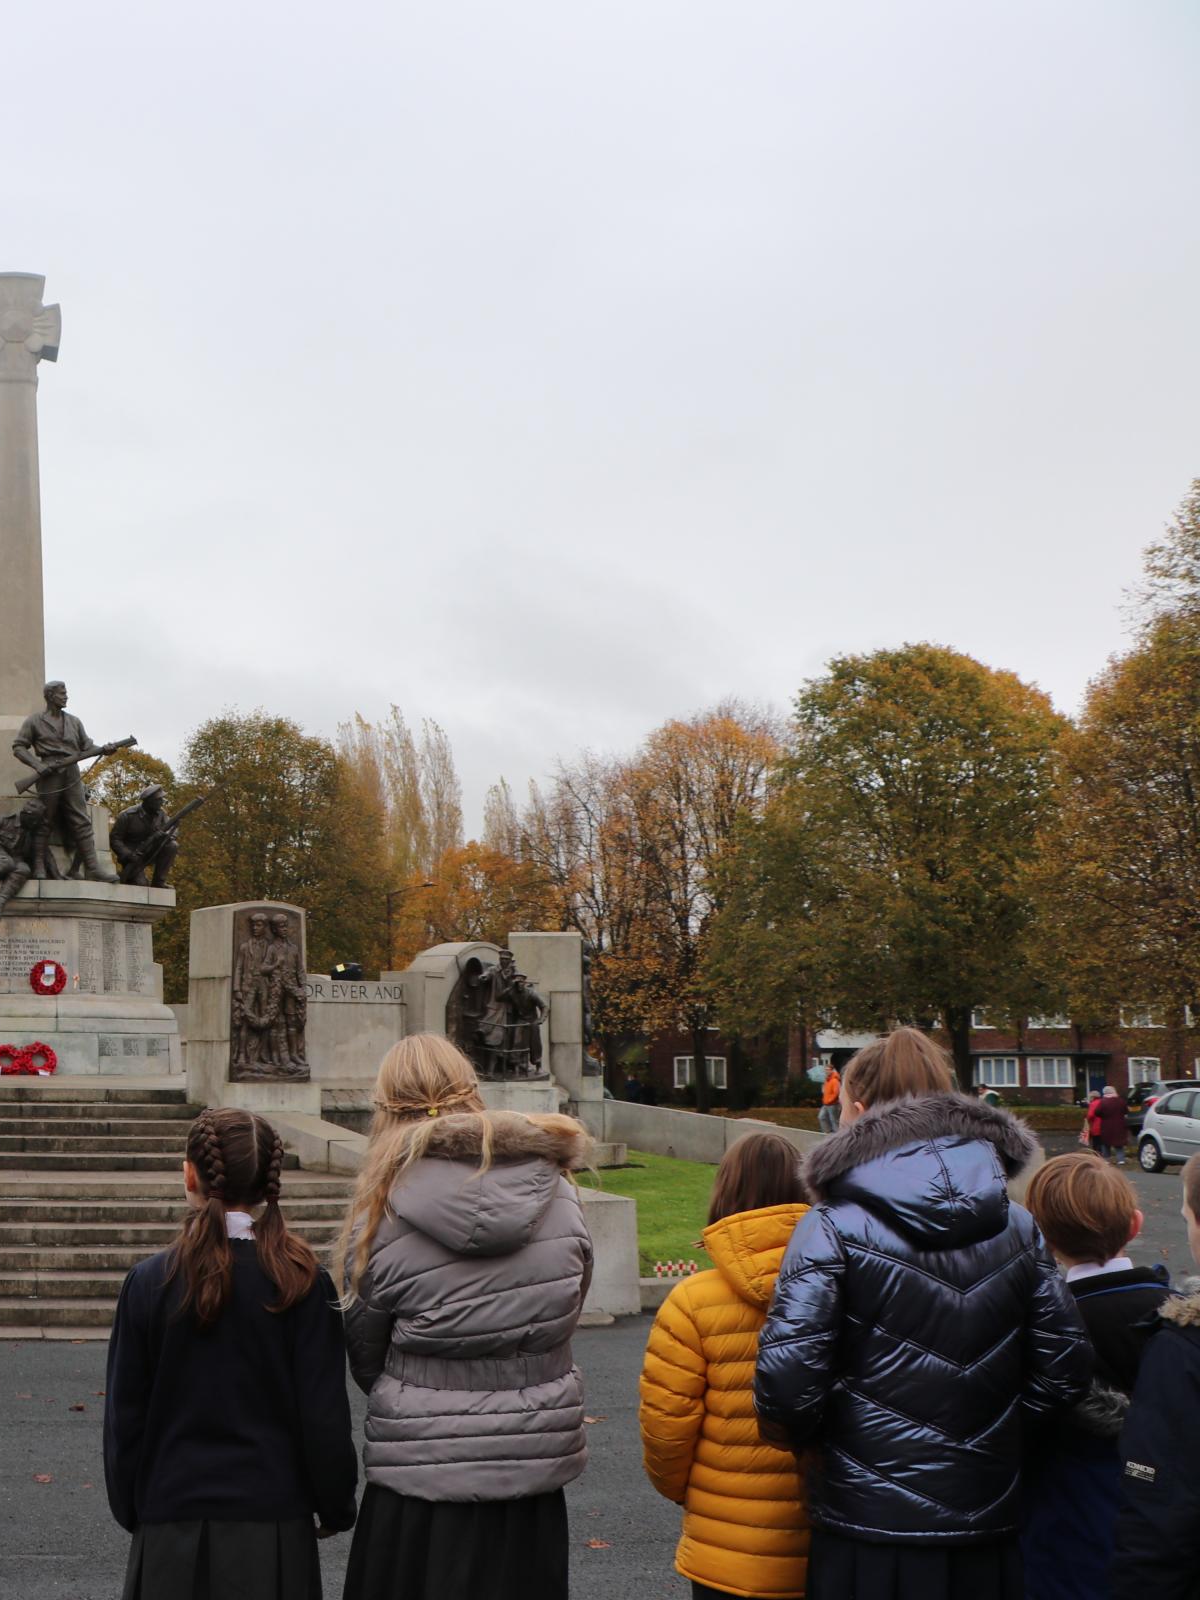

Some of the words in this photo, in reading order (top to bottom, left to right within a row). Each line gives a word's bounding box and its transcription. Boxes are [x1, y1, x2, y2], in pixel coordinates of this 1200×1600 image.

[304, 984, 326, 998] OR
[332, 984, 368, 998] EVER
[374, 986, 402, 1000] AND
